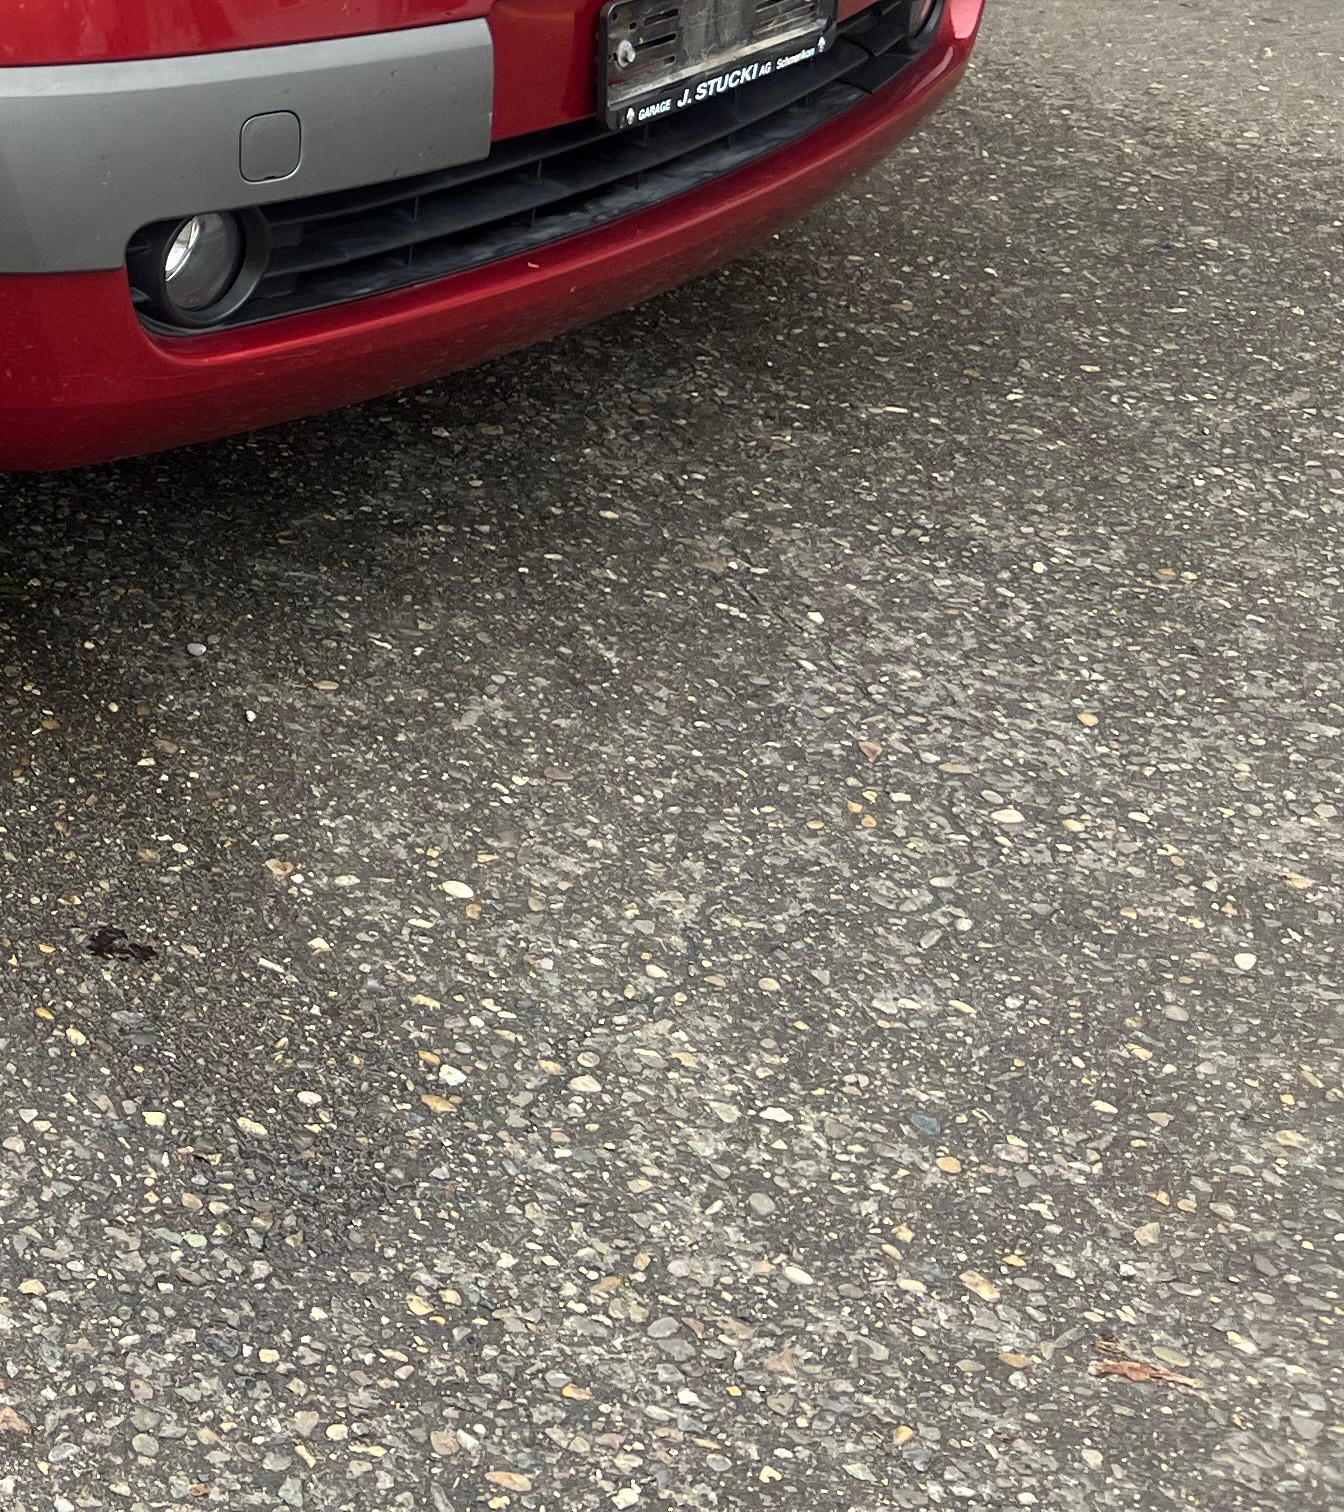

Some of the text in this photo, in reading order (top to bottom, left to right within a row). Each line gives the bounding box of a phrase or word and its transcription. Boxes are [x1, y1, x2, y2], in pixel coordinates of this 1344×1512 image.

[637, 98, 672, 121] GARAGE
[676, 88, 692, 108] J.
[694, 63, 760, 101] STUCKI
[758, 61, 772, 76] AG
